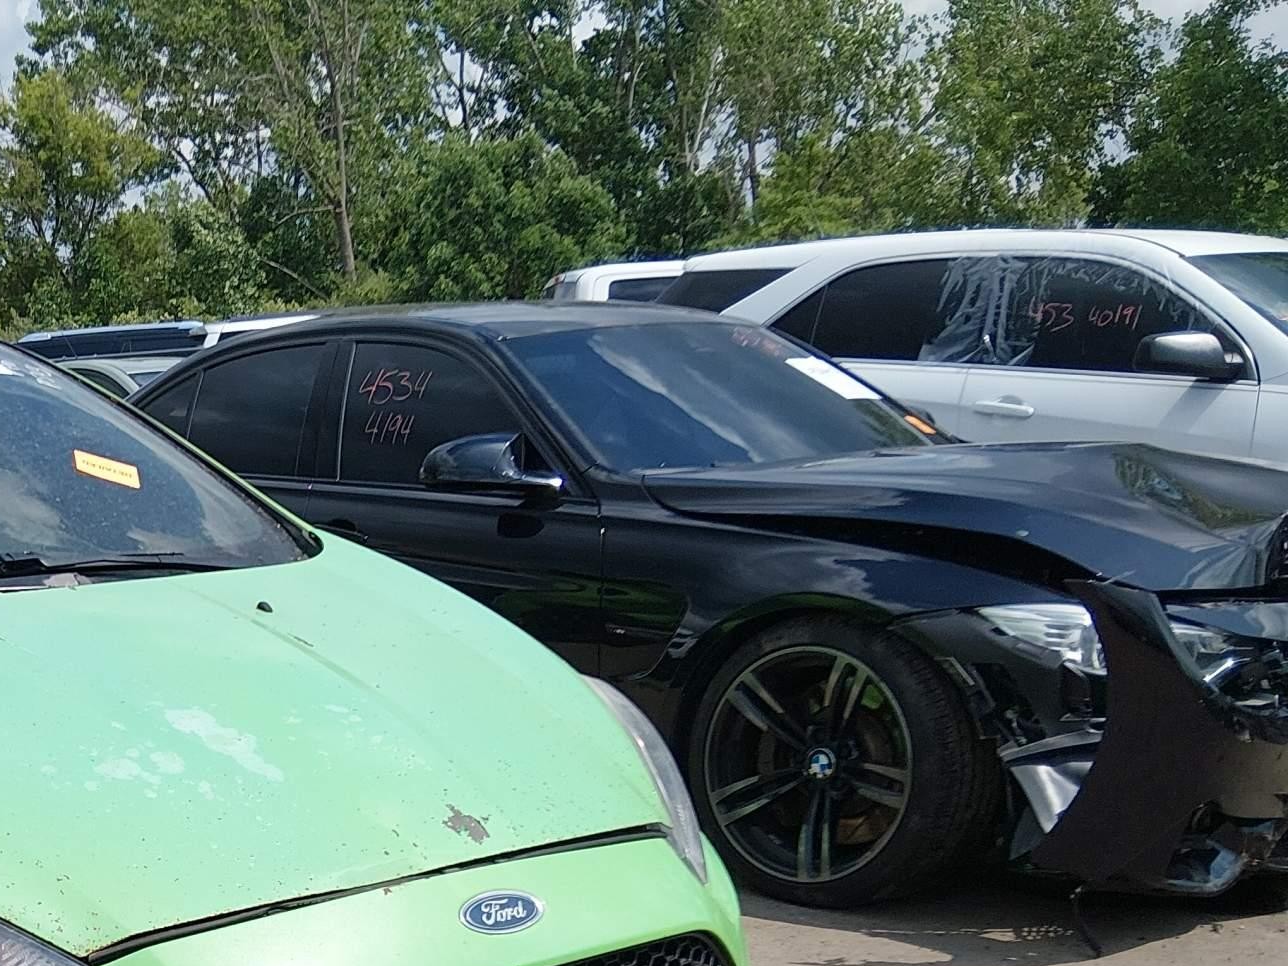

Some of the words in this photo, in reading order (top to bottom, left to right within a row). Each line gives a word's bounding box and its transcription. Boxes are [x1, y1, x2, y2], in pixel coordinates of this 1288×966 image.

[1028, 296, 1074, 332] 453
[1088, 303, 1143, 331] 40191
[358, 368, 433, 406] 4534
[364, 411, 416, 446] 4194
[480, 898, 527, 926] Ford
